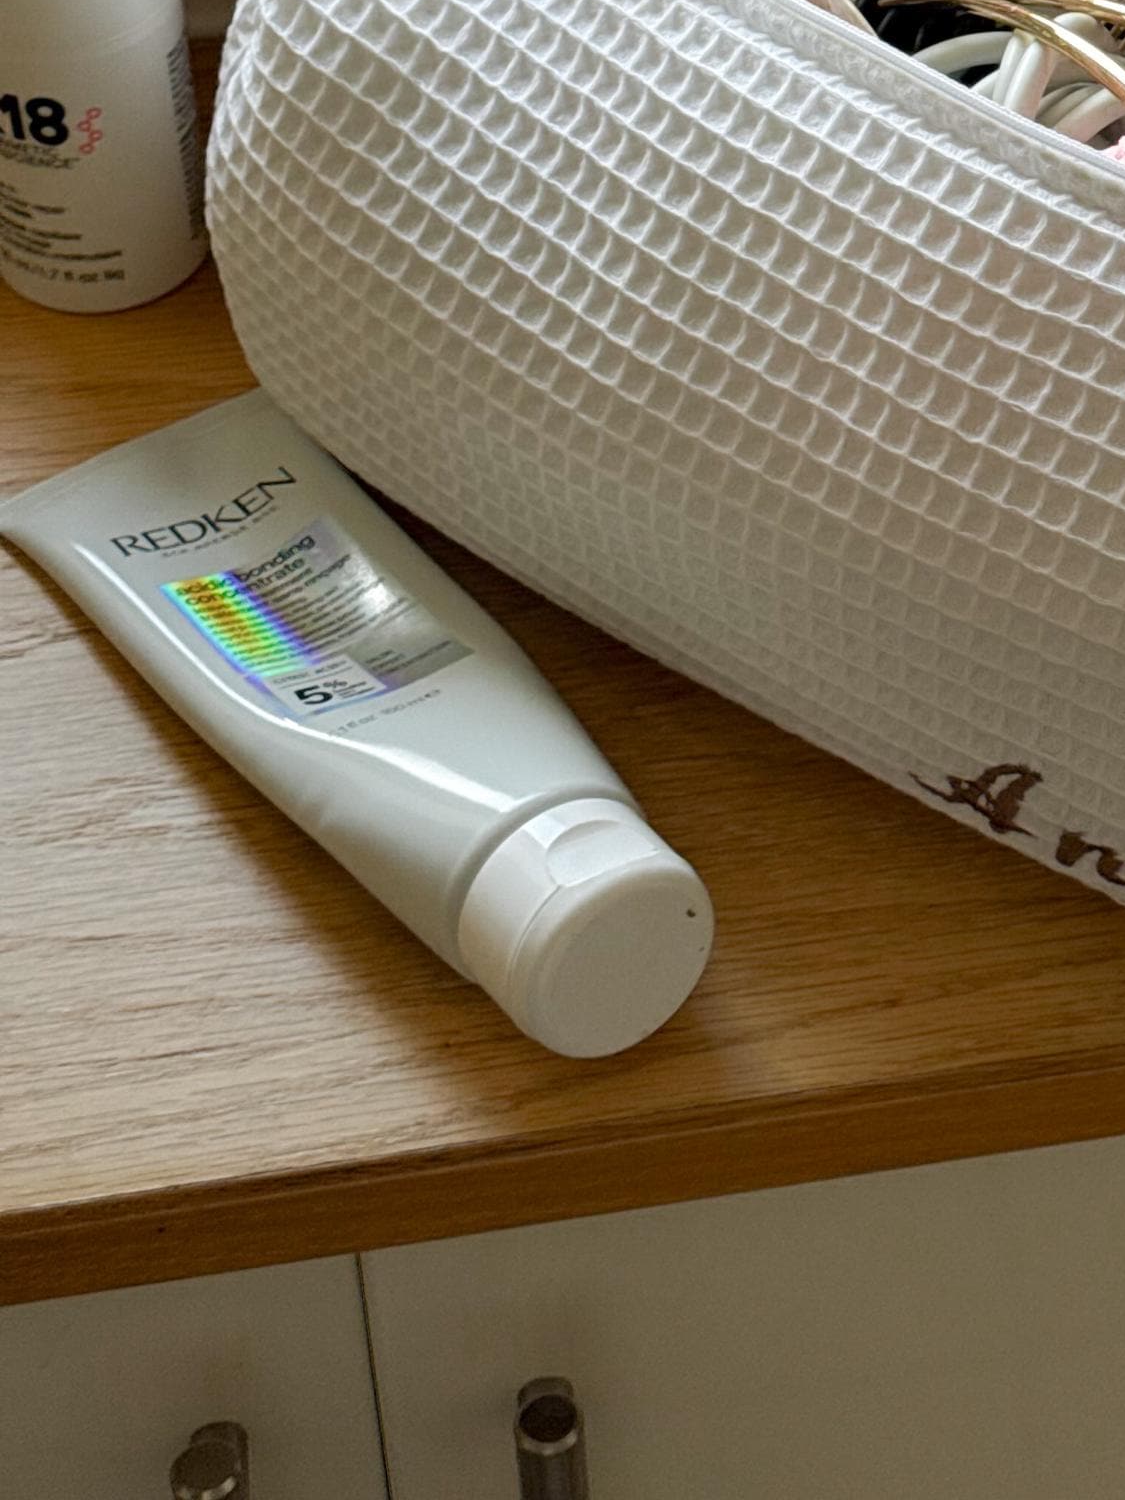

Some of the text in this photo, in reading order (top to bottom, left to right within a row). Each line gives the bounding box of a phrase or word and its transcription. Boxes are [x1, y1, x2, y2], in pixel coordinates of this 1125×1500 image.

[0, 93, 70, 147] 18
[109, 465, 298, 558] REDKEN
[232, 534, 317, 587] bonding
[293, 679, 349, 706] 5%
